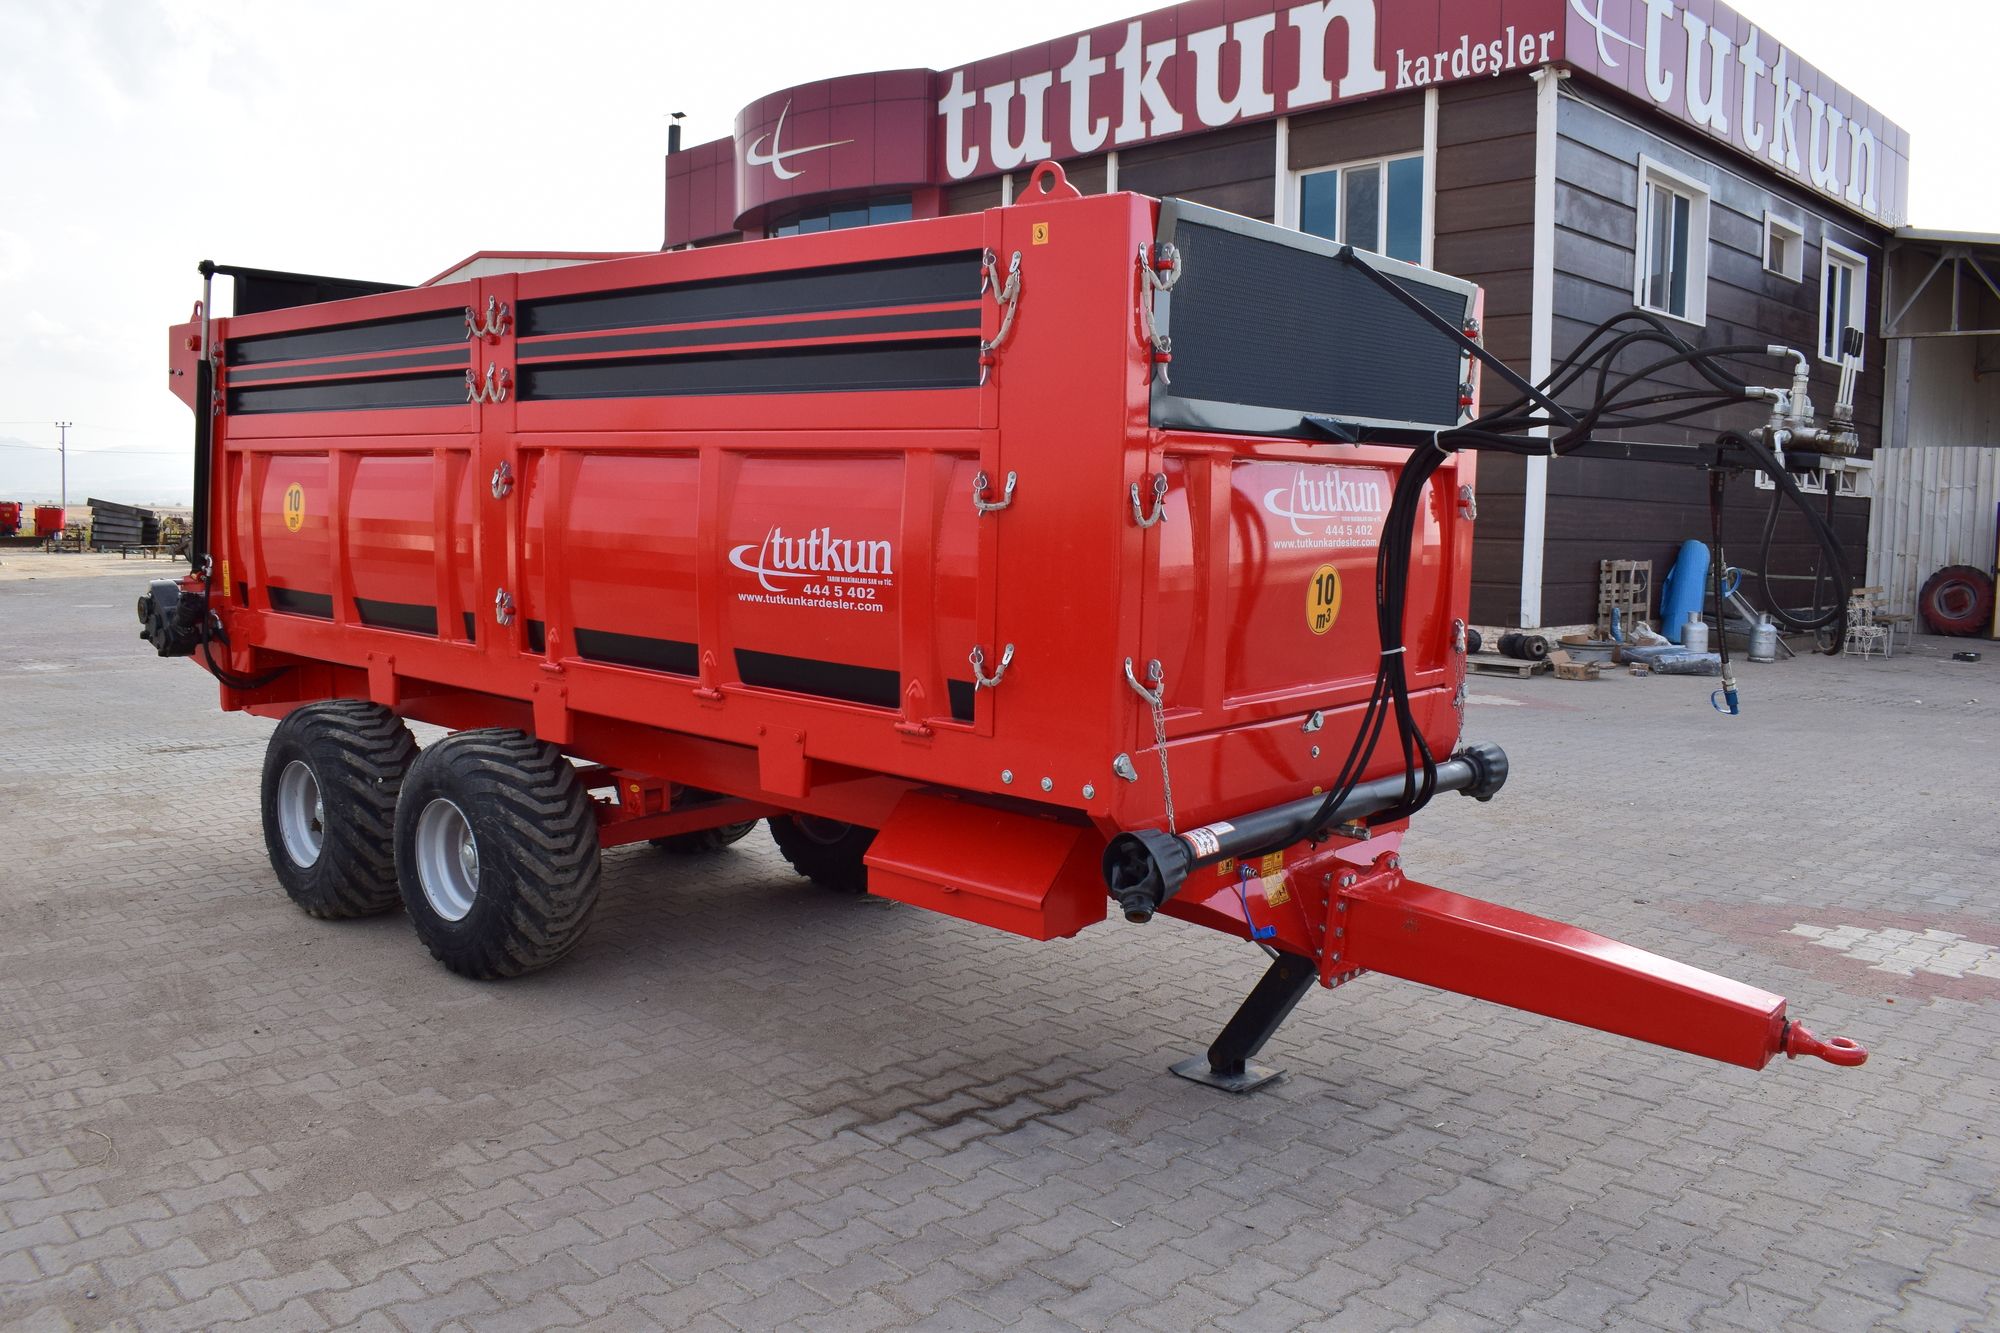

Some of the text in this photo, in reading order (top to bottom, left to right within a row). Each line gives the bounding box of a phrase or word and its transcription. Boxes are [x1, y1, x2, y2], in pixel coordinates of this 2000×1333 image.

[938, 0, 1556, 180] tutkun kardeşler
[1643, 0, 1877, 209] tutkun
[288, 489, 301, 512] 10
[1298, 470, 1382, 512] tutkun
[1273, 537, 1377, 550] www.tutkunkardesler.com
[1325, 524, 1373, 536] 444 5 402
[771, 527, 894, 575] tutkun
[738, 592, 883, 612] www.tutkunkardesler.com
[803, 583, 876, 600] 444 5 402
[1315, 573, 1335, 606] 10
